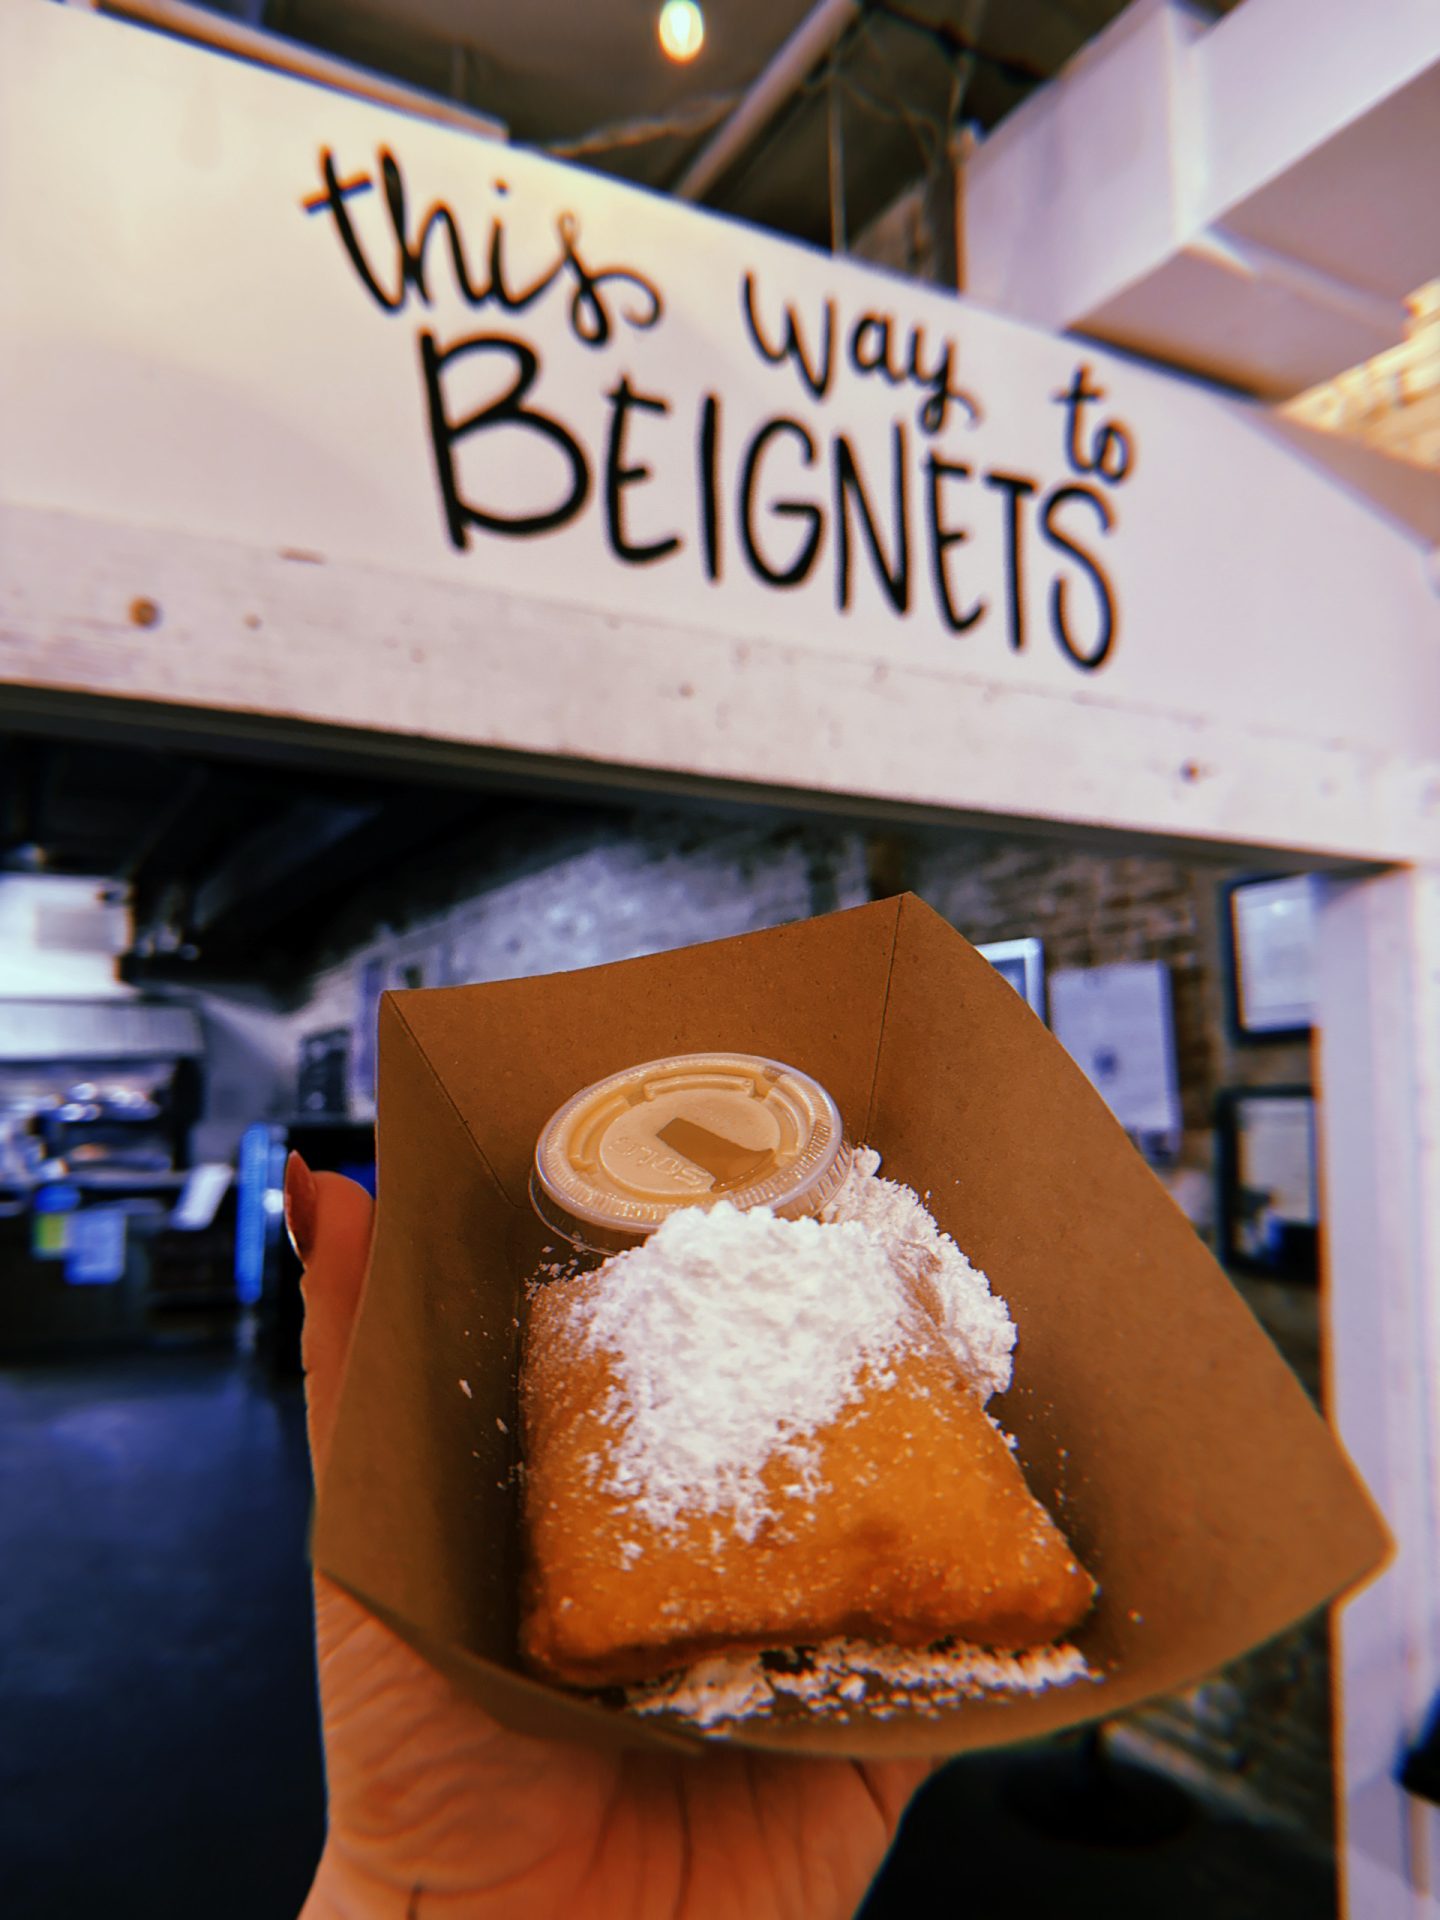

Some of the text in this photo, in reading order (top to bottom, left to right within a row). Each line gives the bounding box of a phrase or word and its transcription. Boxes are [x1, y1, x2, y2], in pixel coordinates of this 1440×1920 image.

[303, 146, 1136, 486] this way to
[417, 327, 1119, 673] BEIGNETS
